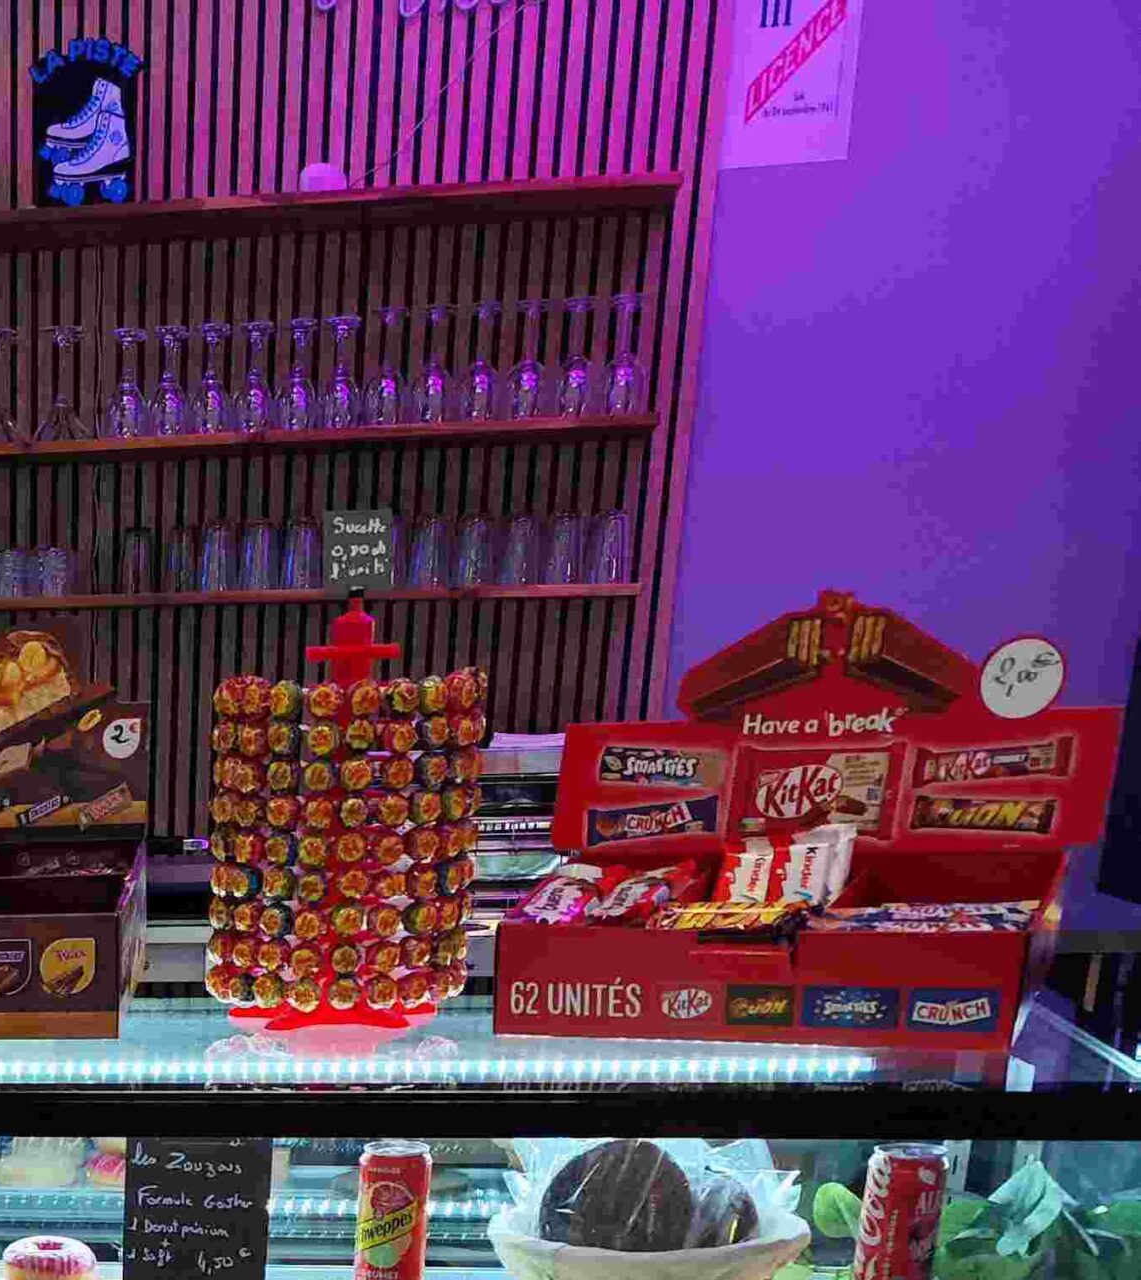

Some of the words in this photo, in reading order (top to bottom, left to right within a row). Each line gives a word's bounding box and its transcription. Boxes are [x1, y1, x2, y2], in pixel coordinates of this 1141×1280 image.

[29, 49, 66, 85] LA
[69, 38, 142, 79] PISTE
[742, 713, 801, 735] Have
[804, 718, 819, 733] a
[827, 706, 898, 737] break
[761, 765, 840, 818] KitKat
[509, 980, 540, 1016] 62
[547, 976, 642, 1018] UNITÉS
[915, 999, 989, 1022] CRUNCH
[144, 1218, 179, 1235] Donut
